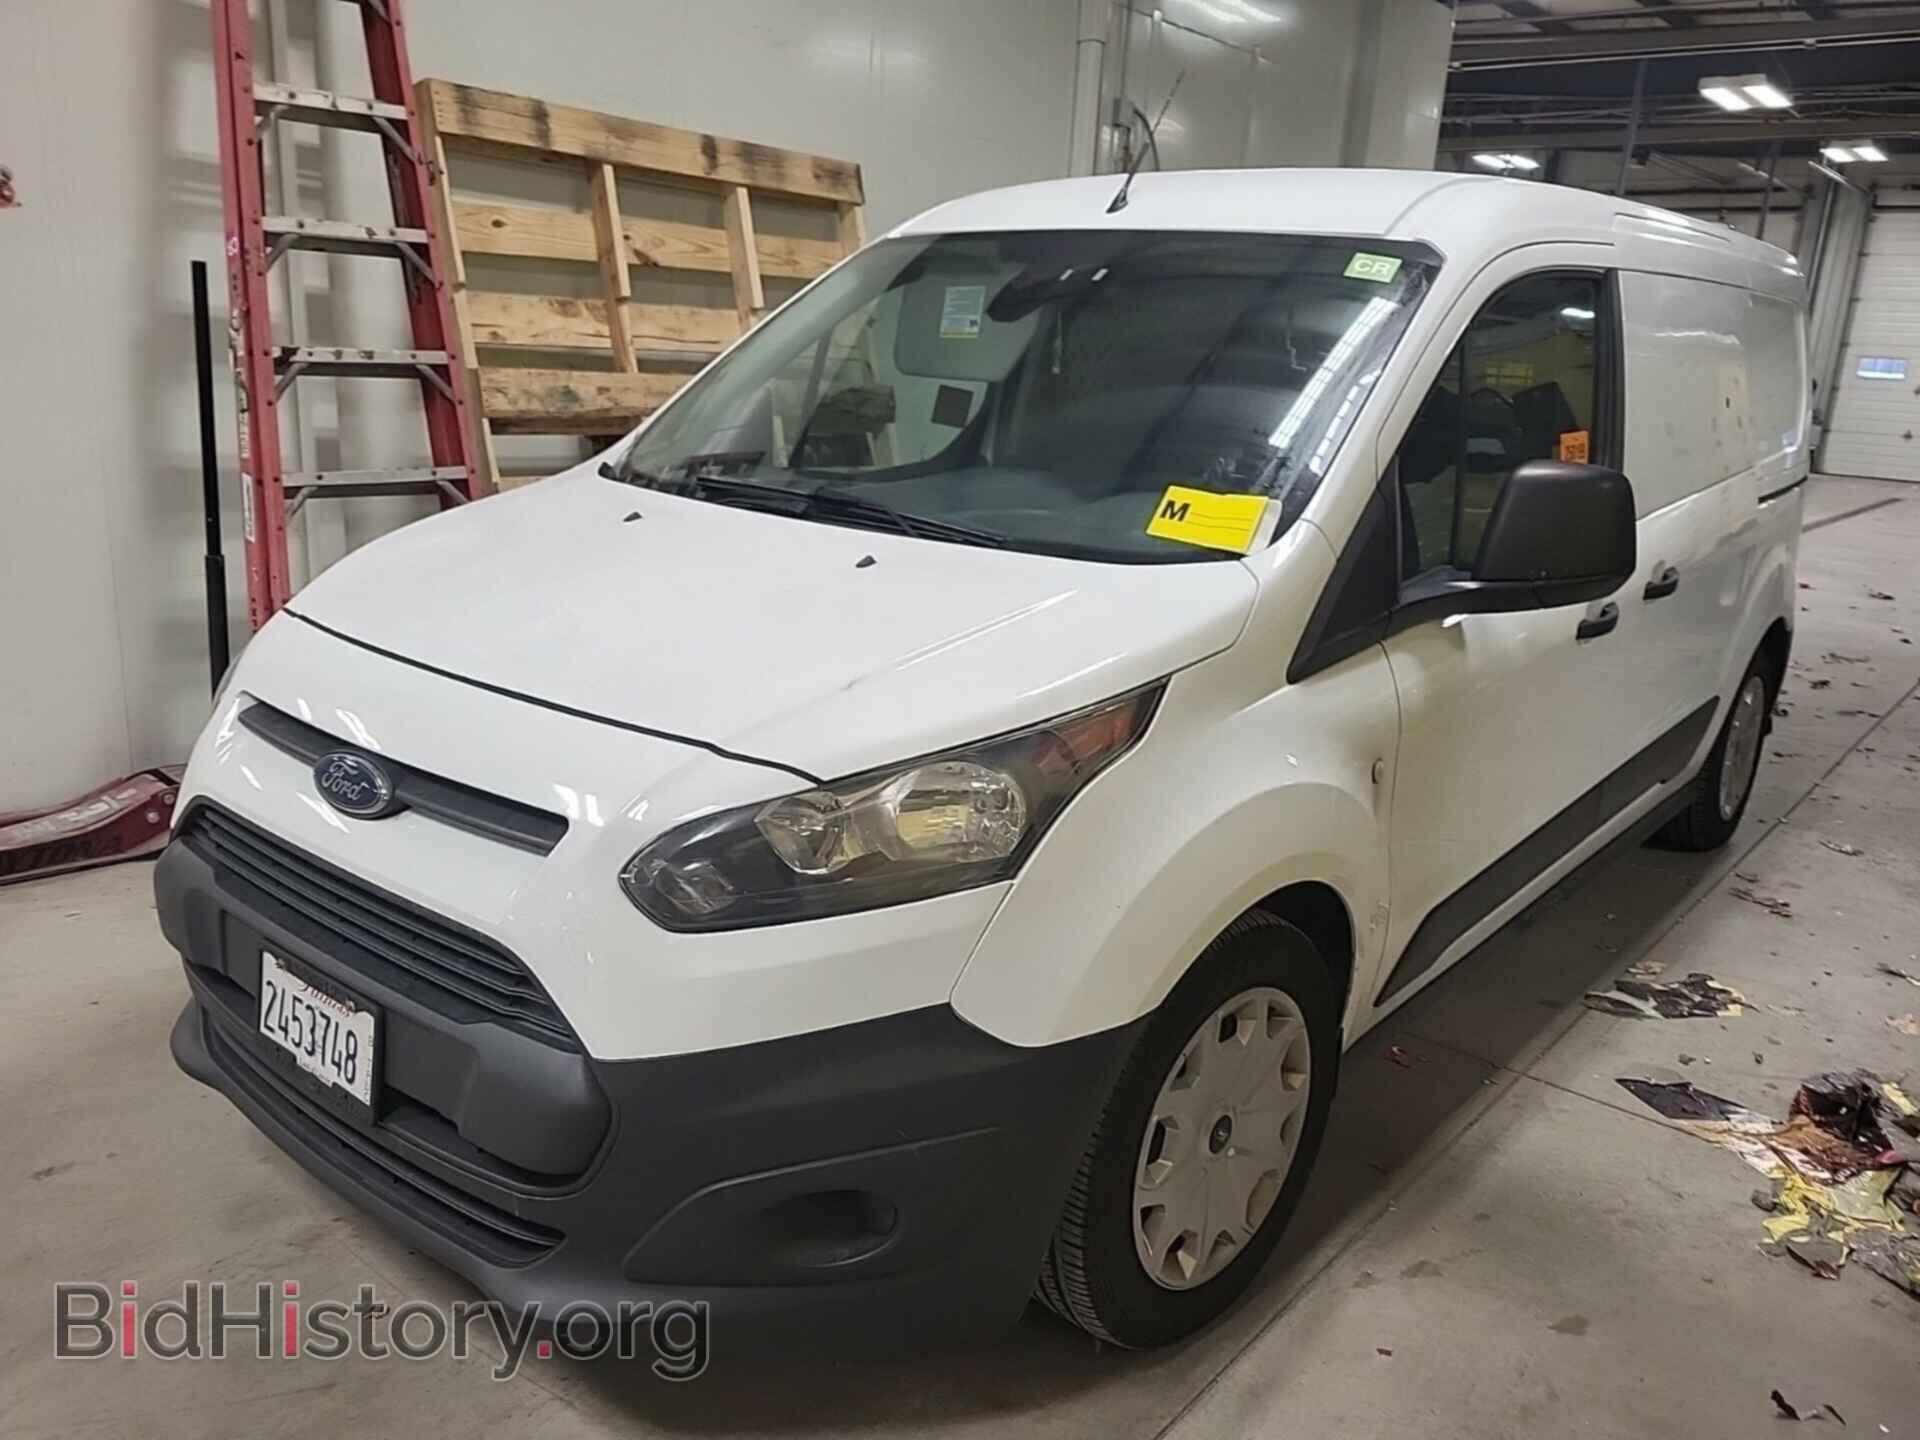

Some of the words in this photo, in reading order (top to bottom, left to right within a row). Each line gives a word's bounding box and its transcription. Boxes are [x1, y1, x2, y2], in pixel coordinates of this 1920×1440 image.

[1159, 499, 1191, 522] M
[320, 760, 370, 801] Ford
[263, 980, 359, 1085] 2453748
